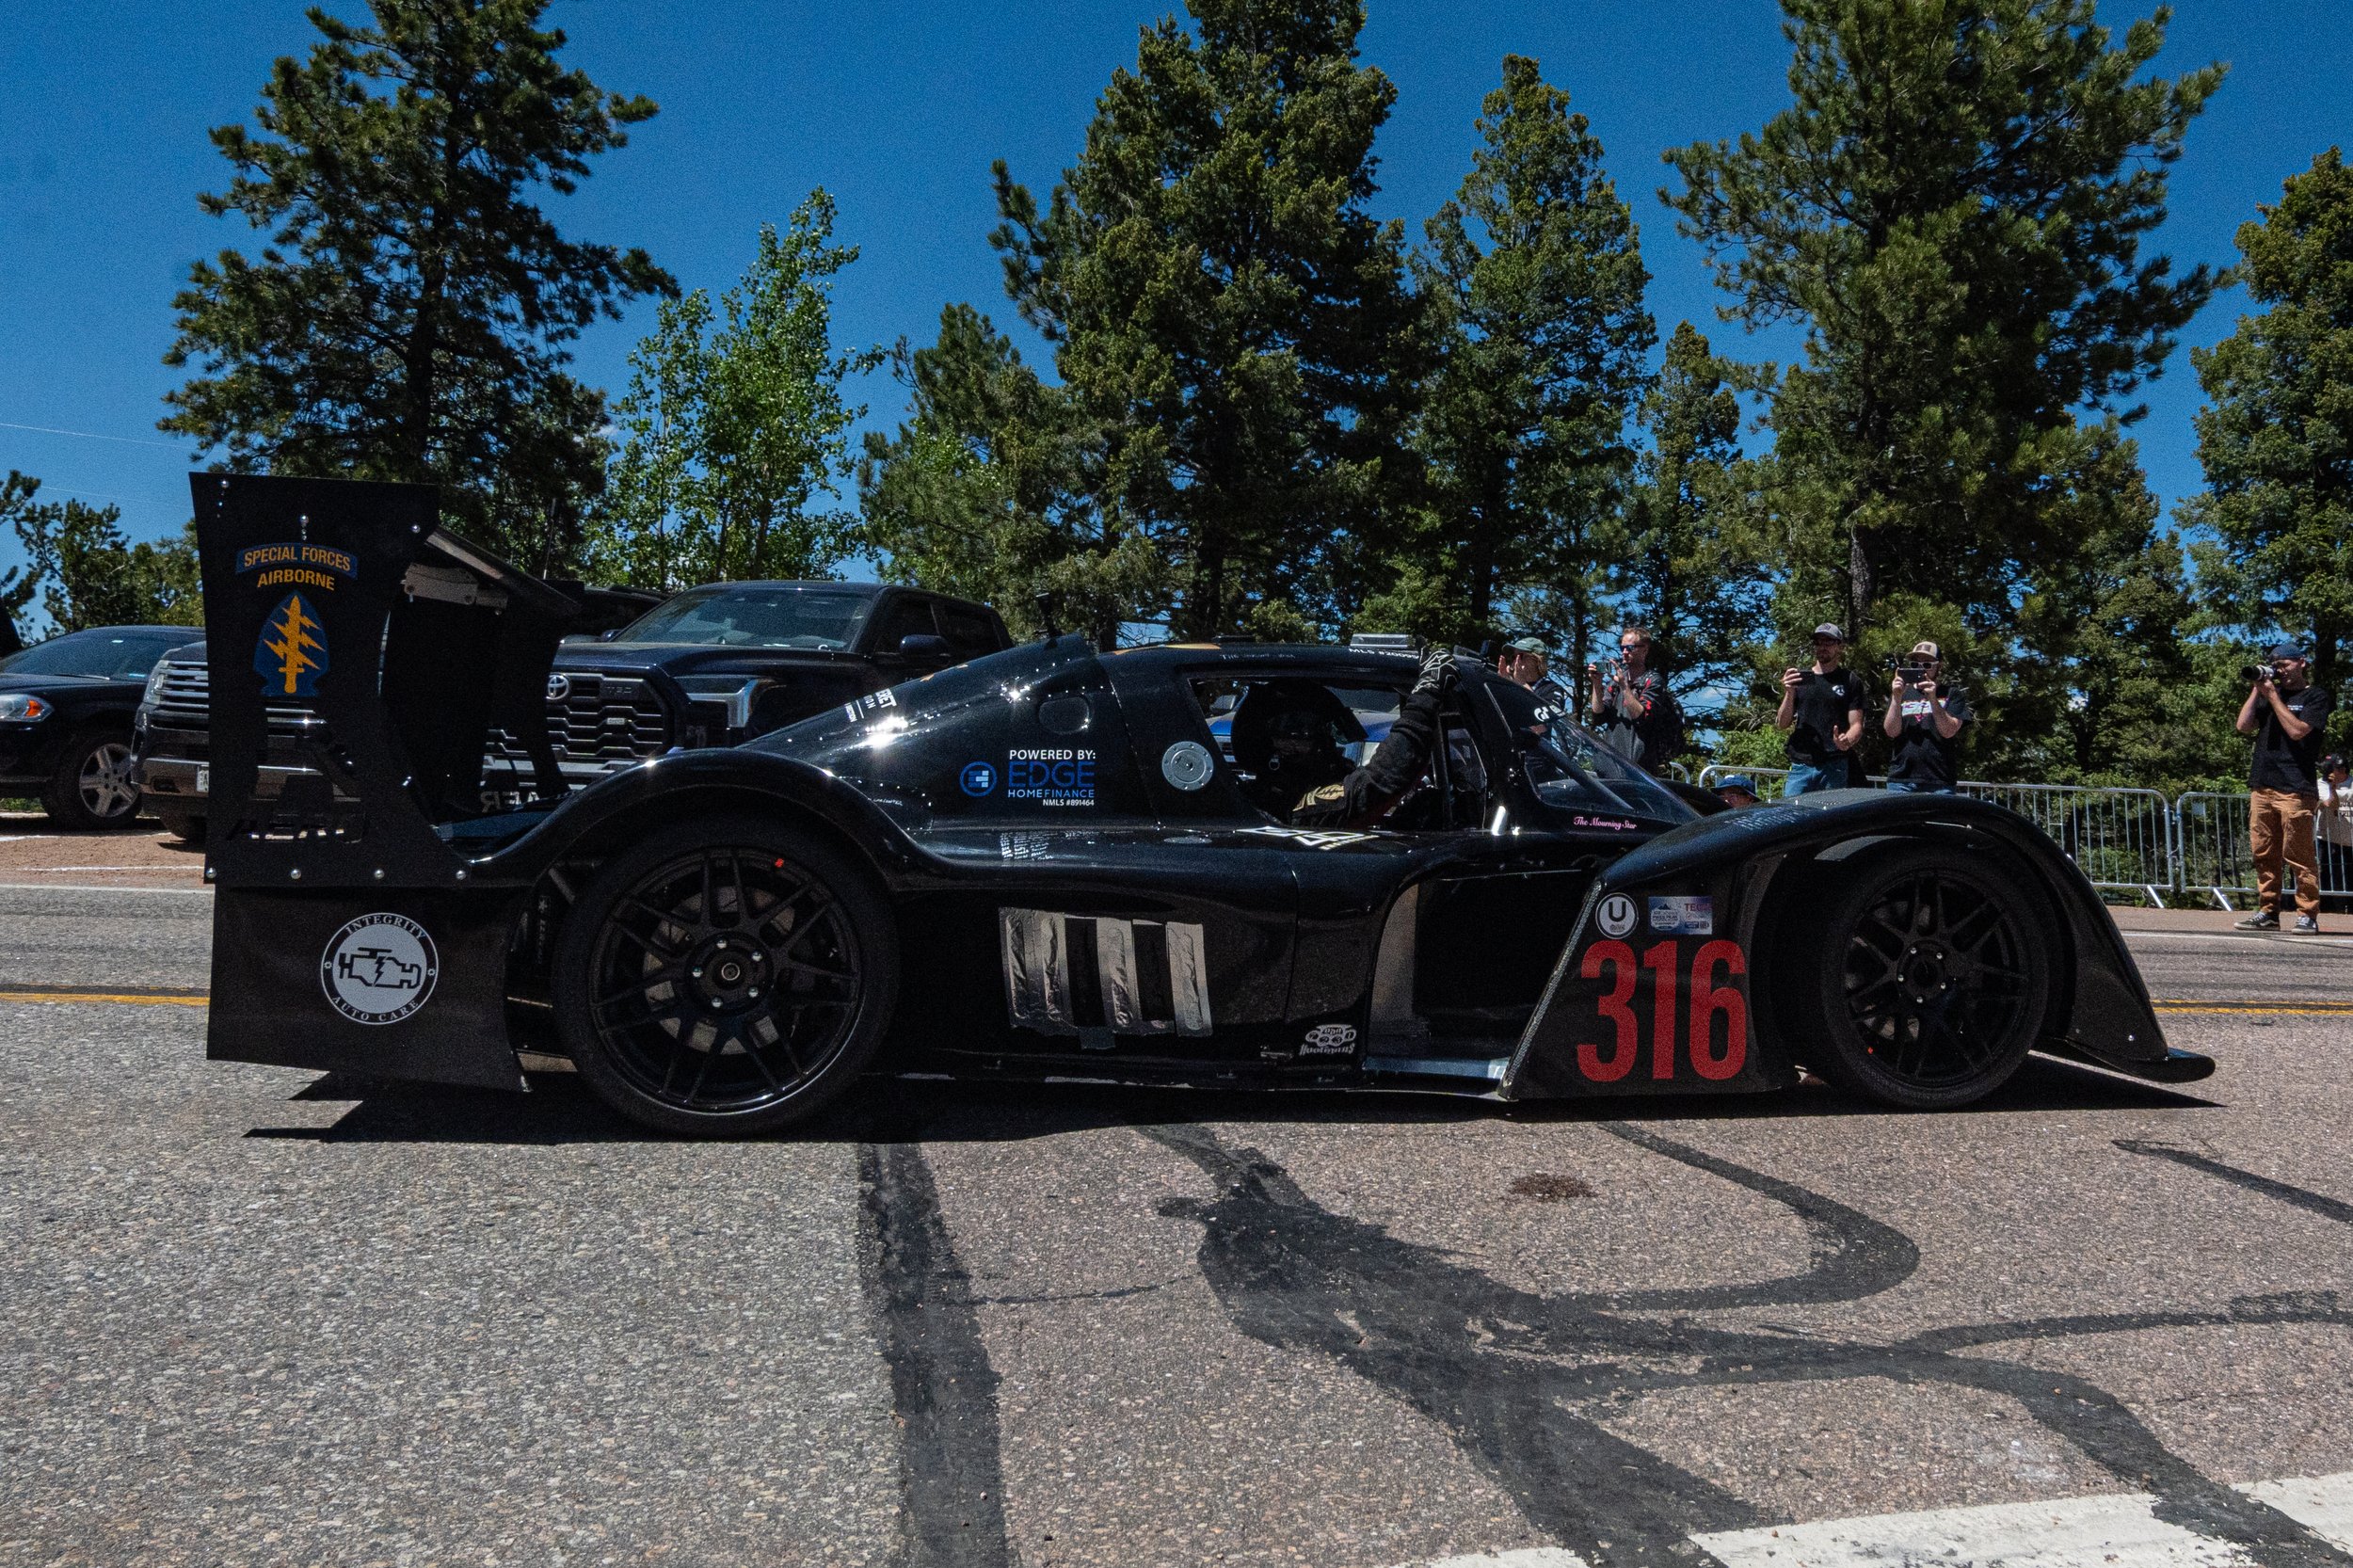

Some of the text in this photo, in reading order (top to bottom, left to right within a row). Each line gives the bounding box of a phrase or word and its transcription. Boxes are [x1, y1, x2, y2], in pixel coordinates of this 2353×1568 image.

[244, 546, 351, 572] SPECIAL FORCES
[257, 568, 335, 591] AIRBORNE
[1009, 749, 1096, 760] POWERED BY:
[1008, 760, 1095, 788] EDGE
[1042, 798, 1095, 807] NMLS #891464
[1573, 816, 1638, 831] The Mourning Star
[1609, 901, 1626, 922] U
[344, 914, 426, 939] INTEGRITY
[331, 996, 419, 1021] AUTO CARE
[1577, 938, 1748, 1083] 316
